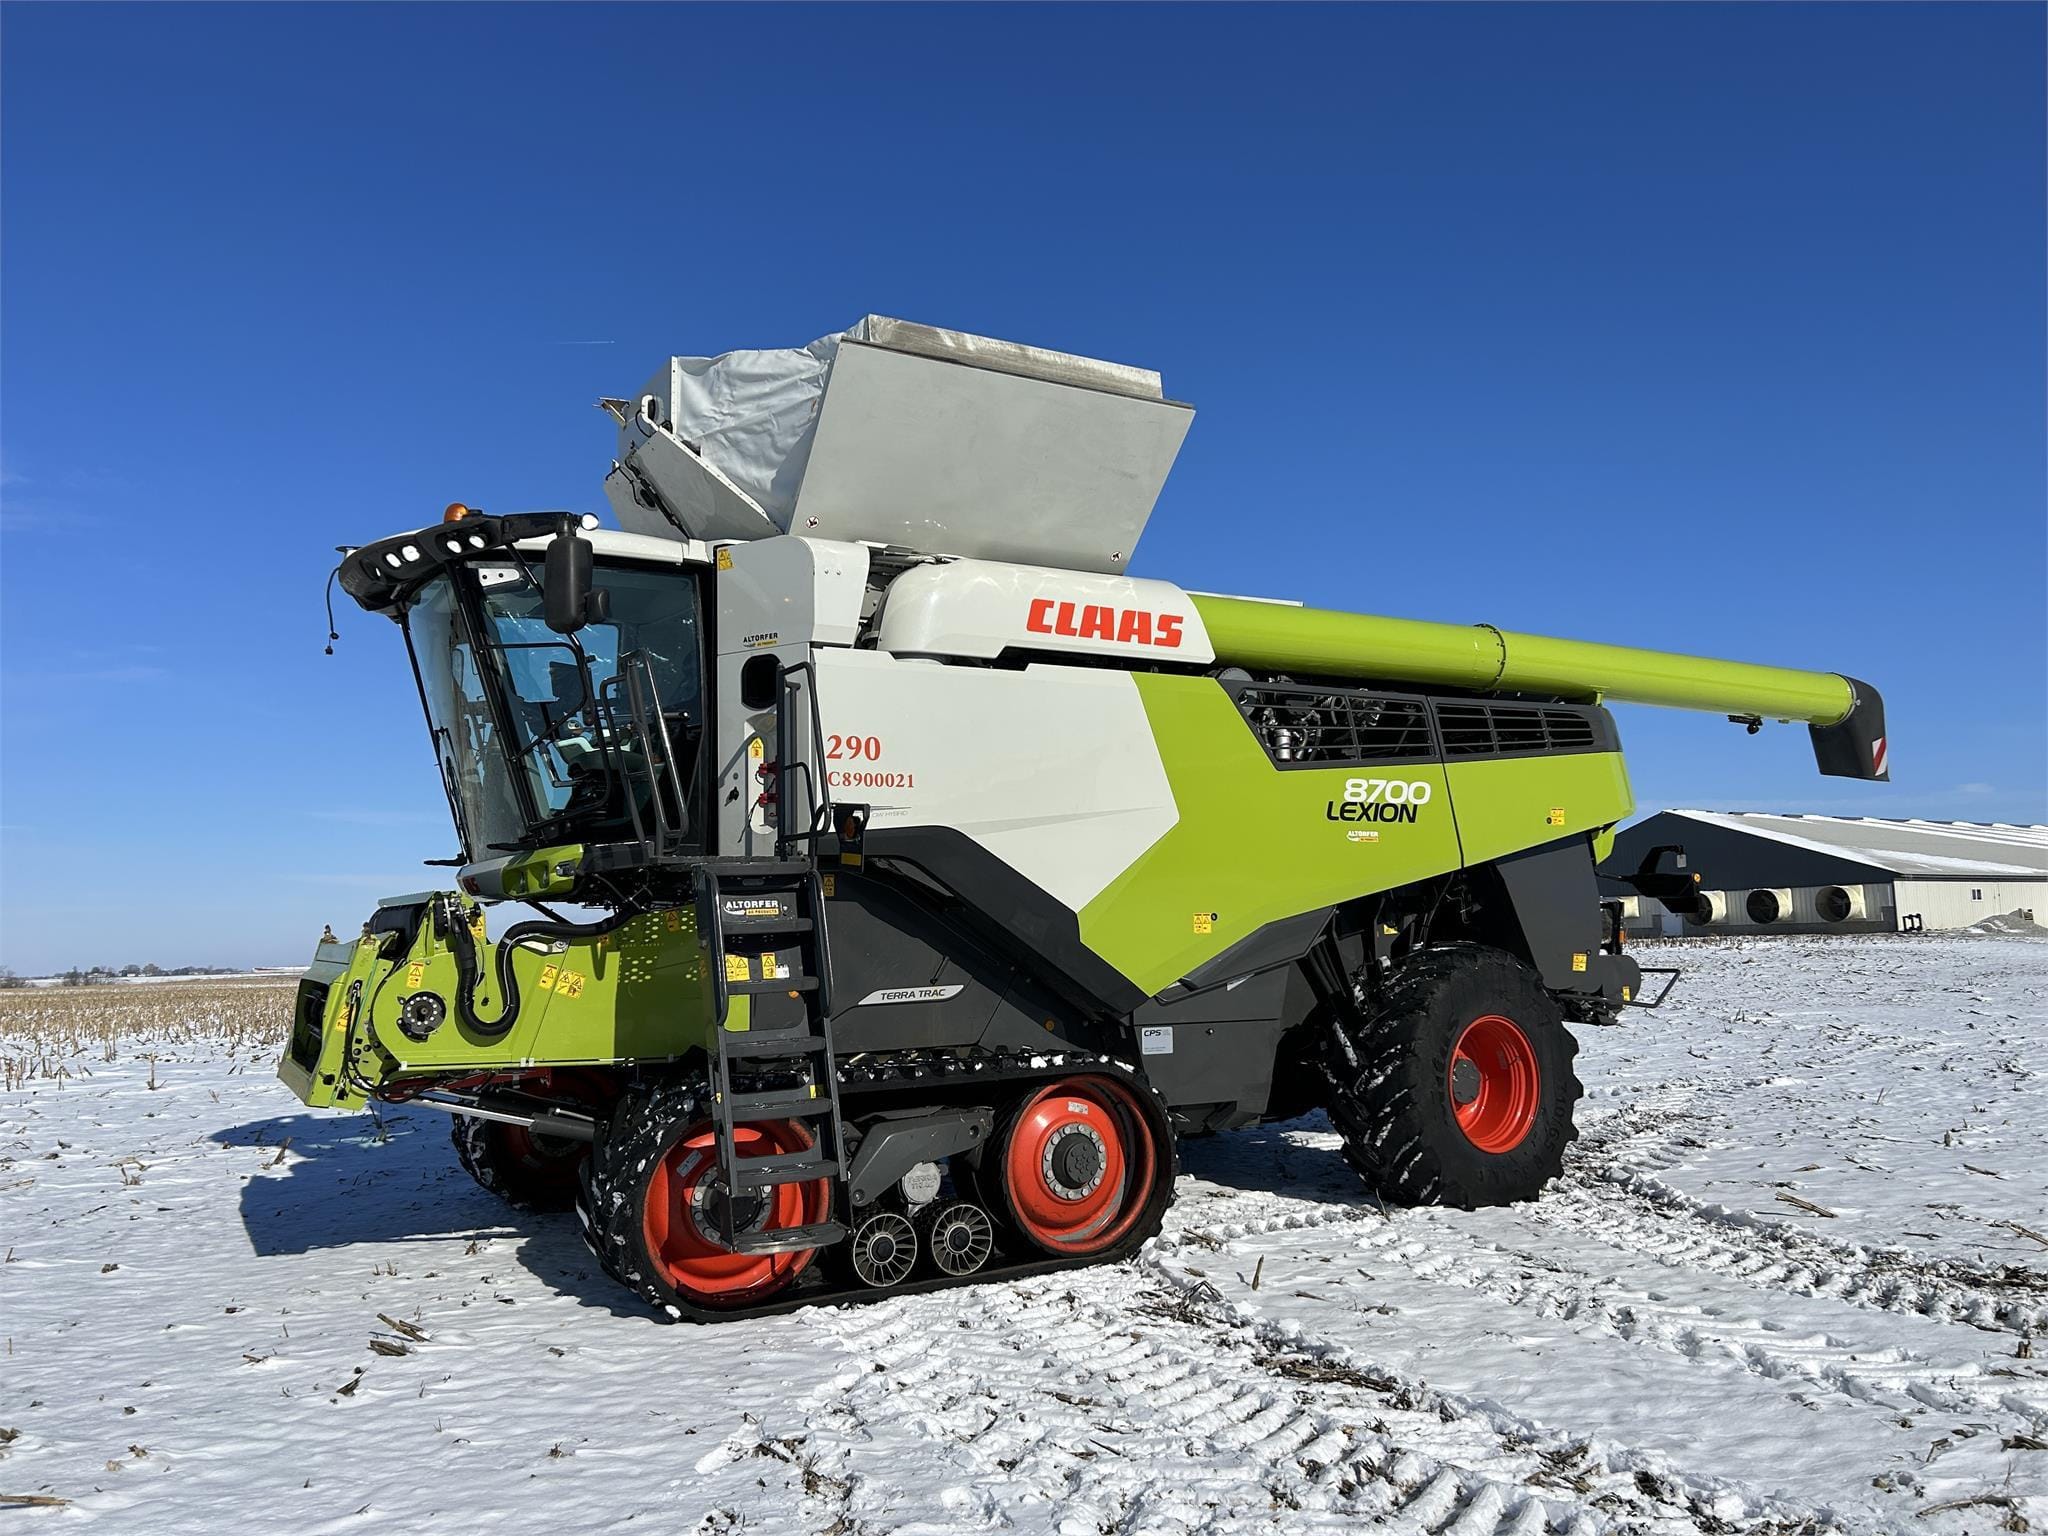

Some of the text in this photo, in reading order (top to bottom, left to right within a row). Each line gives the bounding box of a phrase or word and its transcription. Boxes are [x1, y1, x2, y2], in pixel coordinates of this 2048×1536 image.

[1026, 598, 1184, 648] CLAAS
[743, 632, 778, 643] ALTORFER
[826, 735, 881, 761] 290
[827, 771, 914, 788] C8900021
[1343, 778, 1431, 805] 8700
[1326, 801, 1417, 823] LEXION
[725, 900, 778, 909] ALTORFER
[880, 988, 946, 1000] TERRA TRAC
[1143, 1029, 1162, 1037] CPS
